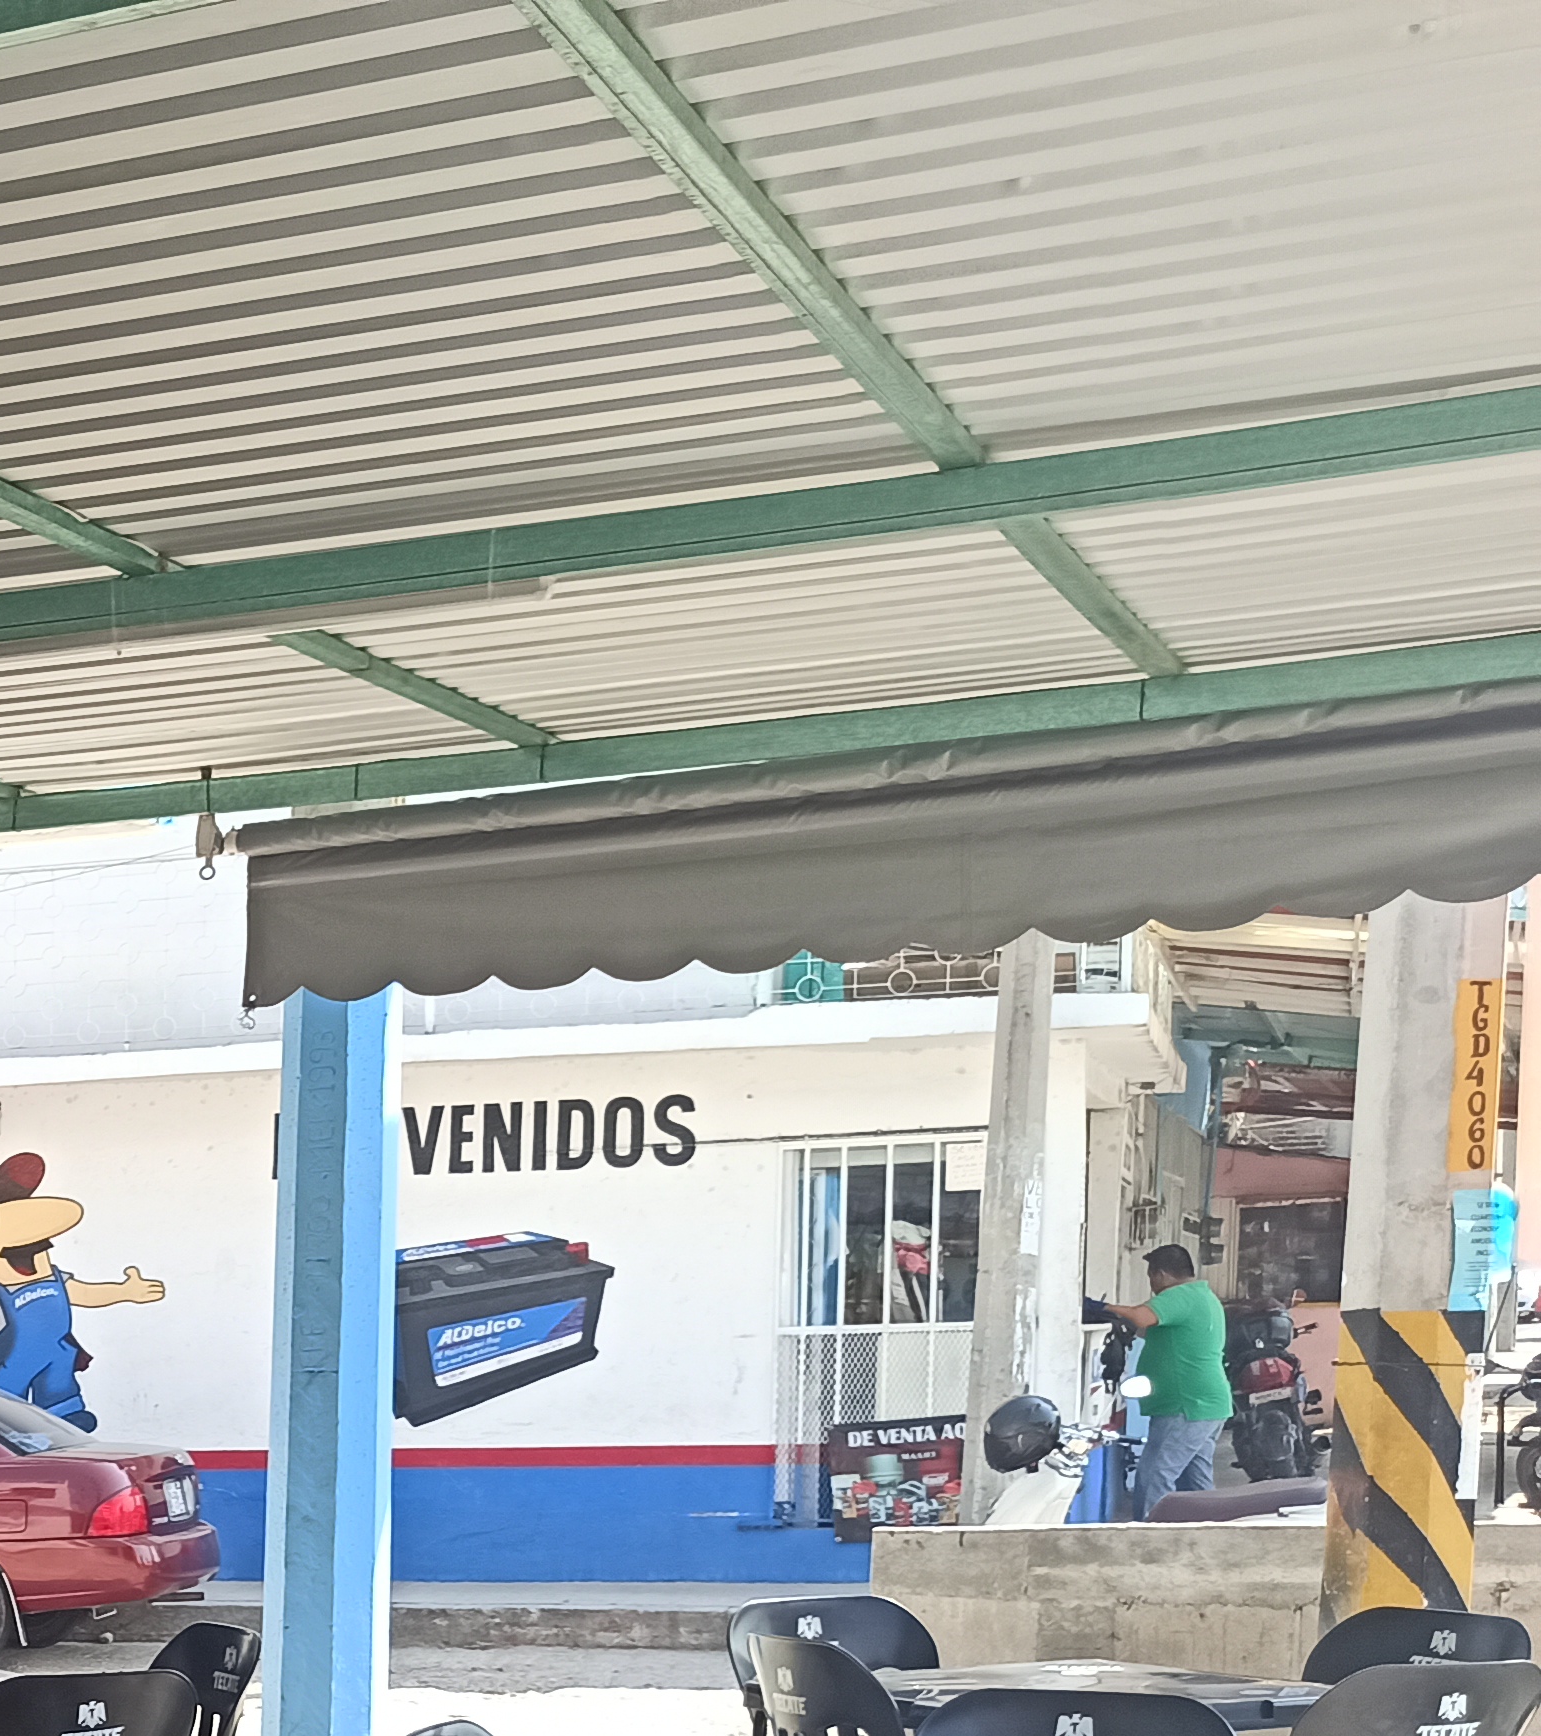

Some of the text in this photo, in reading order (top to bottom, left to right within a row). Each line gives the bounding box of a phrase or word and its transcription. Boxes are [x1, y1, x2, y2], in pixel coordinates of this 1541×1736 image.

[404, 1094, 697, 1175] VENIDOS
[847, 1422, 966, 1447] DE VENTA AQ
